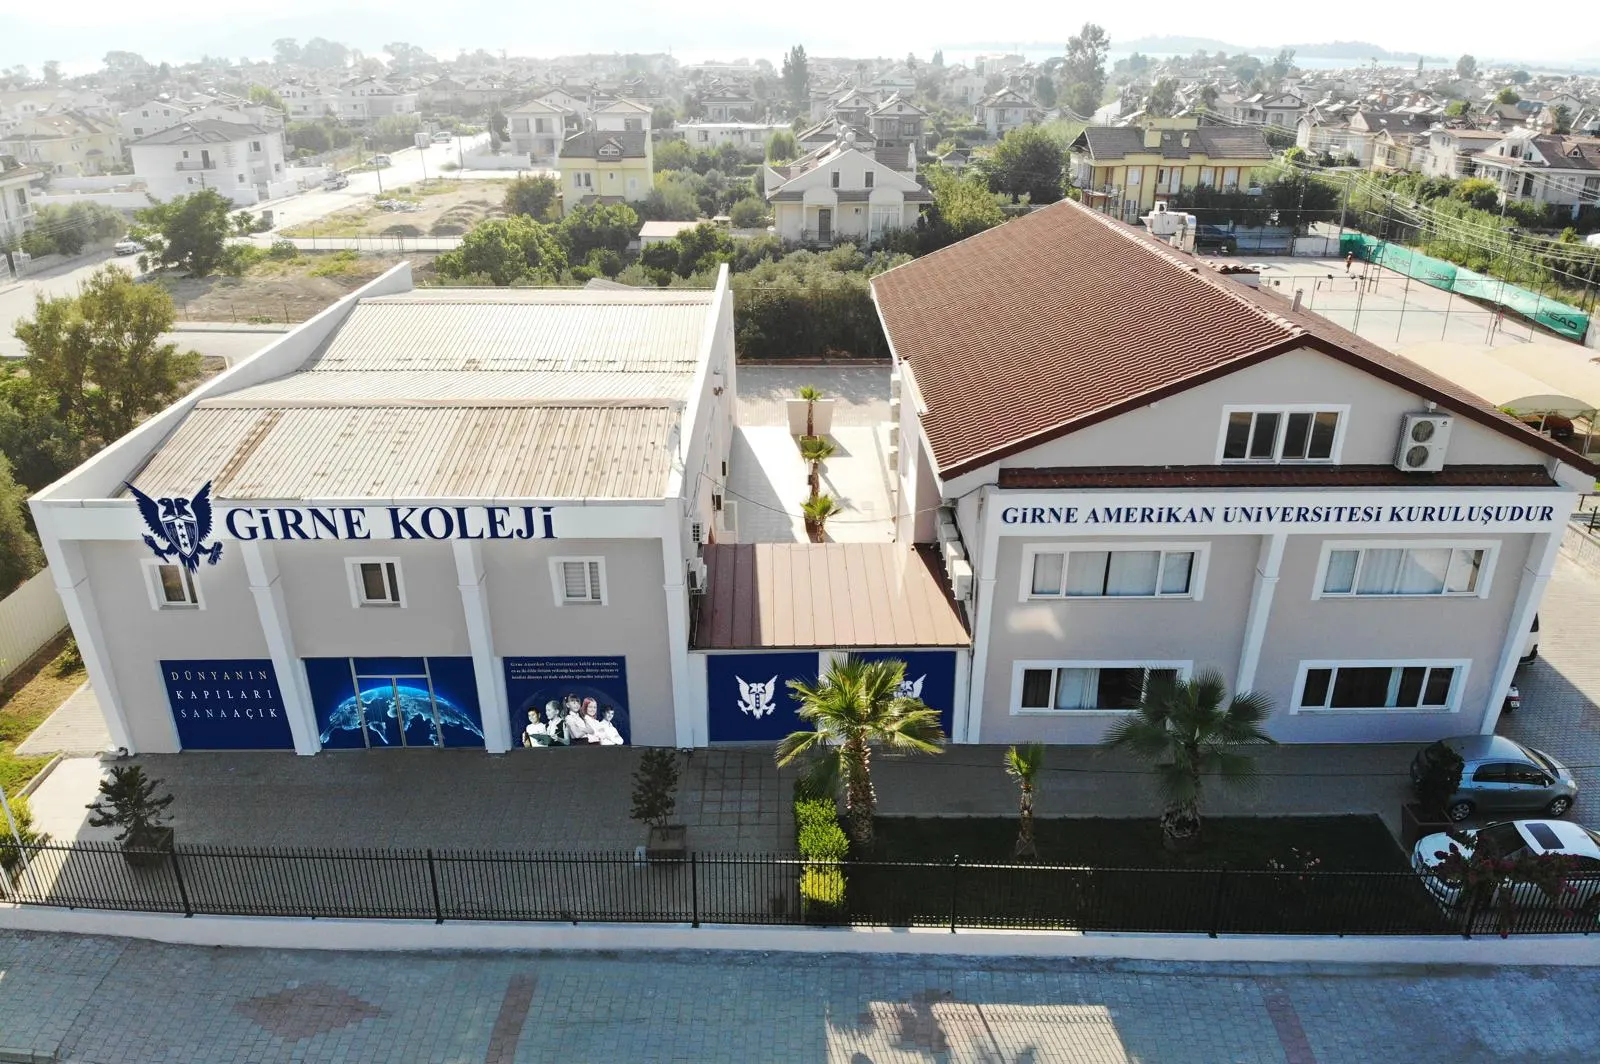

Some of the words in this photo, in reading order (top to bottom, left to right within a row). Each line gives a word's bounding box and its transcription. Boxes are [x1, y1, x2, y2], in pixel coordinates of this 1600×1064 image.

[1541, 307, 1578, 330] HEAD
[1388, 505, 1555, 526] KURULUŞUDUR
[171, 670, 268, 681] DÜNYANIN
[176, 690, 273, 699] KAPILARI
